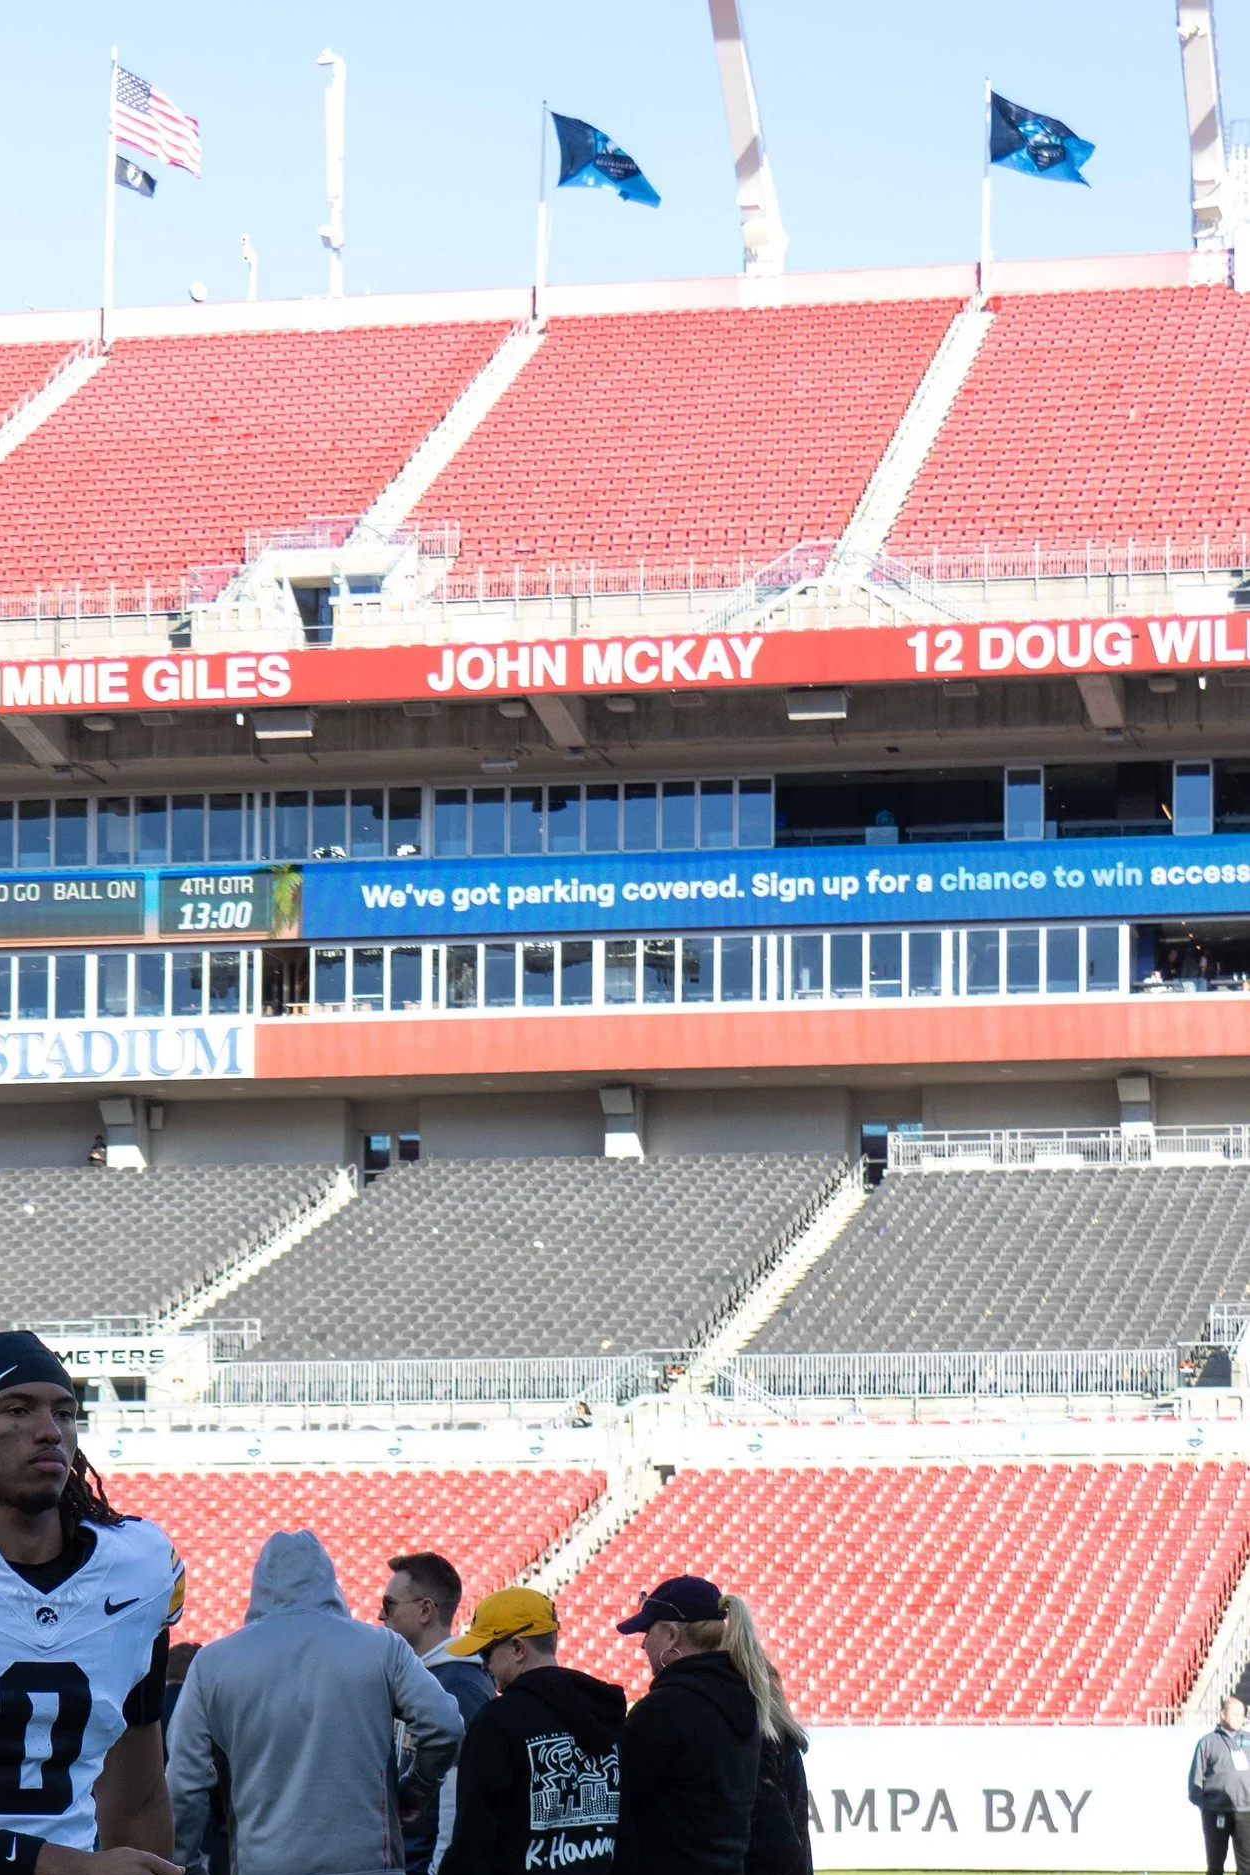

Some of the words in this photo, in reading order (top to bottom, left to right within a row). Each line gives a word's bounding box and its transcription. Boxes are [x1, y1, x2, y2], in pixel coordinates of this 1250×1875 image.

[907, 631, 963, 672] 12
[979, 622, 1133, 670] DOUG
[1147, 618, 1250, 664] WIL
[142, 655, 292, 702] GILES
[427, 645, 567, 691] JOHN
[583, 637, 763, 685] MCKAY
[13, 883, 40, 901] GO
[53, 882, 102, 900] BALL
[107, 881, 136, 899] ON
[180, 877, 219, 896] 4TH
[222, 875, 255, 894] QTR
[361, 884, 445, 908] We've
[452, 883, 501, 911] got
[507, 878, 615, 911] parking
[621, 873, 745, 901] covered.
[751, 871, 815, 902] Sign
[822, 877, 859, 900] up
[866, 870, 907, 894] for
[915, 874, 933, 893] a
[940, 866, 1047, 892] chance
[1052, 865, 1085, 889] to
[1091, 863, 1143, 887] win
[1150, 864, 1250, 886] access
[178, 901, 253, 930] 13:00
[54, 1349, 166, 1365] METERS
[982, 1788, 1093, 1834] BAY
